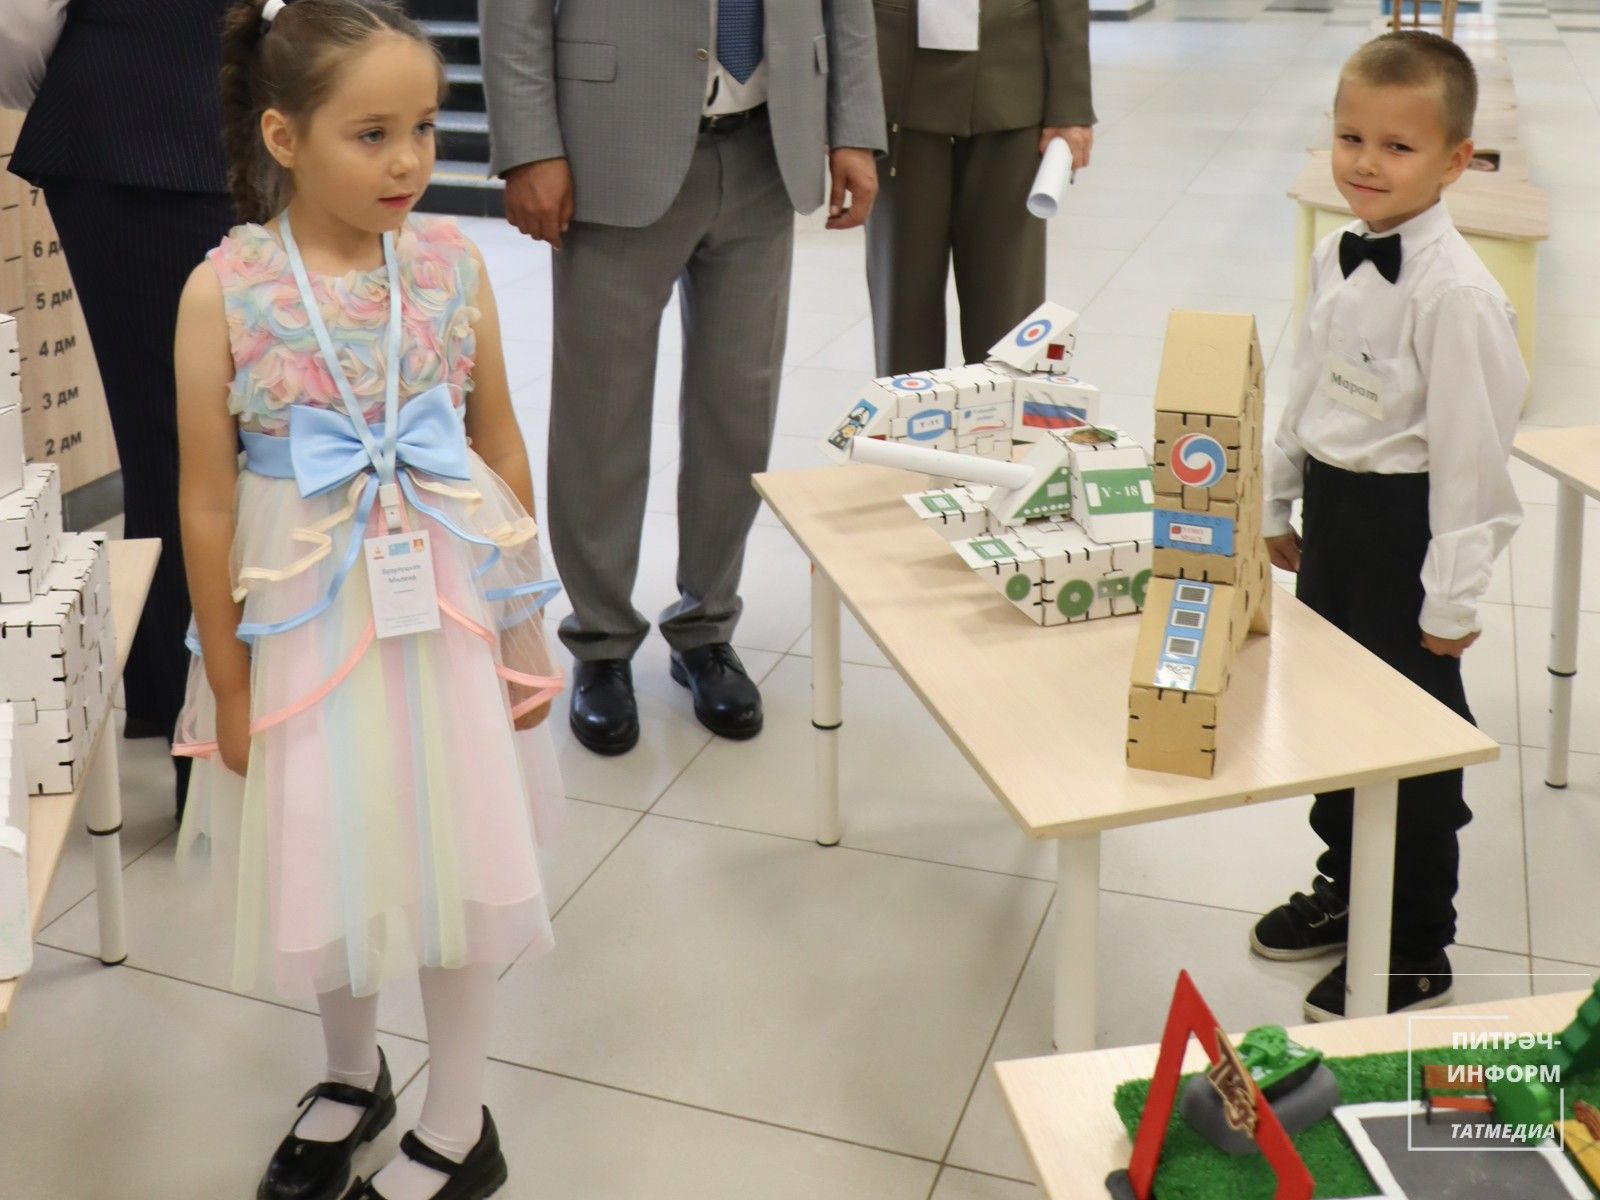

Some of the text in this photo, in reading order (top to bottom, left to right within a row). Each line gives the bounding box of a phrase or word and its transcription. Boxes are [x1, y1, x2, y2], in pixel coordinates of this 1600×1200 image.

[30, 189, 39, 206] 7
[33, 241, 43, 258] 6
[36, 287, 73, 310] 5 дм
[39, 335, 76, 357] 4 дм
[42, 385, 79, 410] 3 дм
[45, 430, 82, 457] 2 дм
